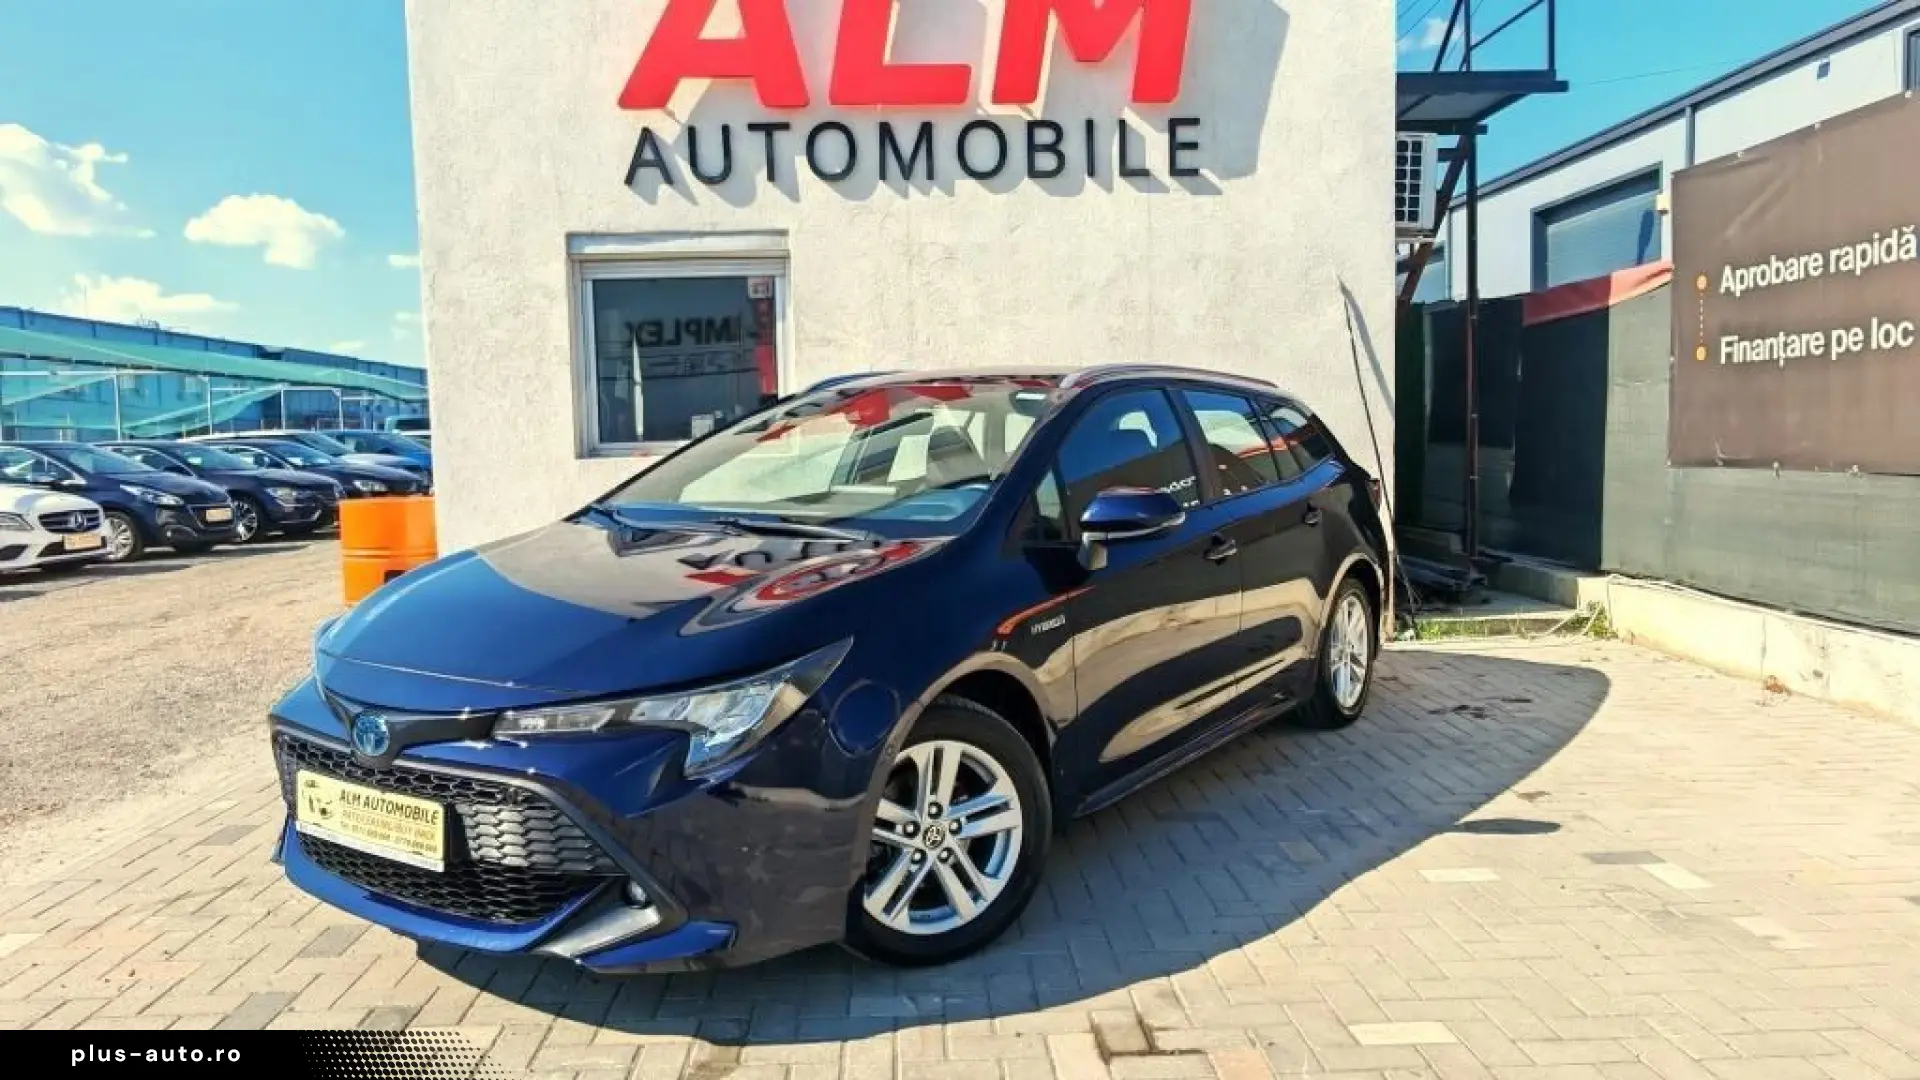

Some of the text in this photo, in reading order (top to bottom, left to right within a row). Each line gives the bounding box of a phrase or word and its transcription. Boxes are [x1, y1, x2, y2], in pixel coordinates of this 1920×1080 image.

[617, 0, 1192, 109] ALM
[624, 117, 1201, 186] AUTOMOBILE
[1719, 225, 1917, 297] Aprobare rapidă
[1720, 317, 1915, 369] Finanțare pe loc
[339, 789, 439, 825] ALM AUTOMOBILE
